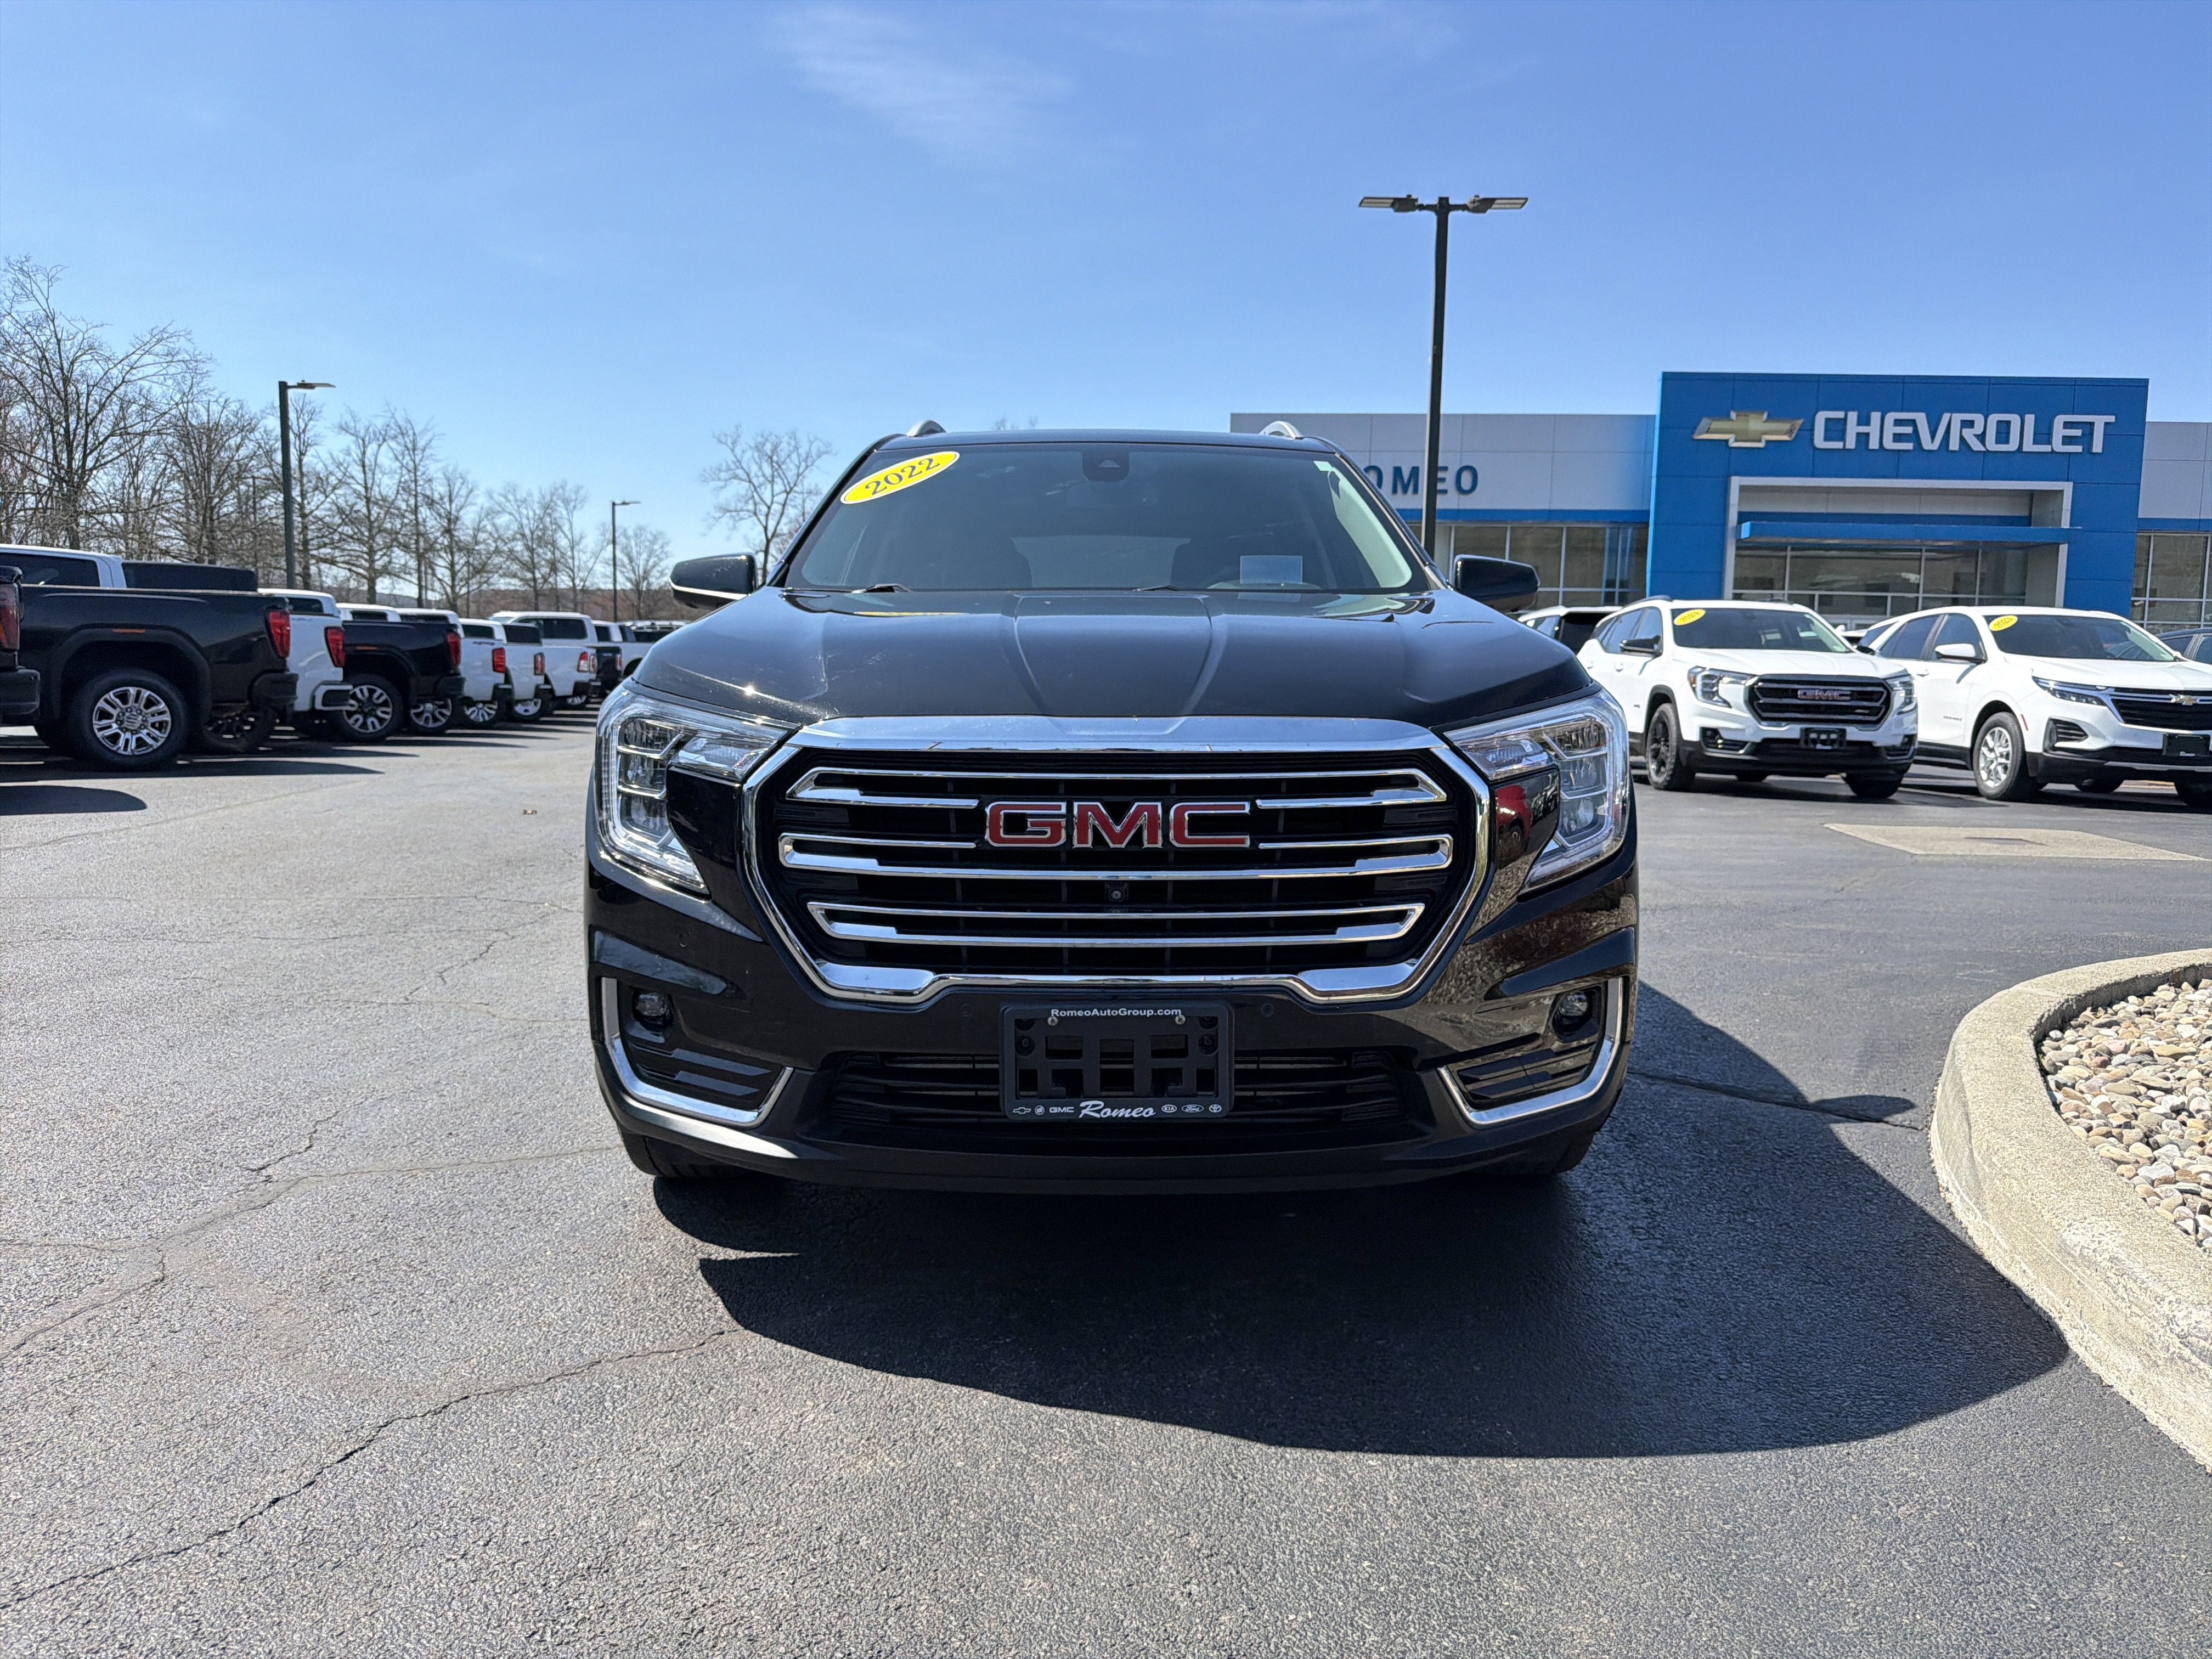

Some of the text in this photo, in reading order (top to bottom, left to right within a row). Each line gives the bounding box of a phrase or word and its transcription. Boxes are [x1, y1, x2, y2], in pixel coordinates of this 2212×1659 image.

[1813, 411, 2115, 453] CHEVROLET
[865, 458, 940, 496] 2022
[1364, 465, 1478, 495] OMEO
[1797, 689, 1851, 700] GMC
[985, 801, 1250, 848] GMC
[1051, 1008, 1181, 1018] RomeoAutoGroup.com
[1079, 1100, 1156, 1119] Romeo
